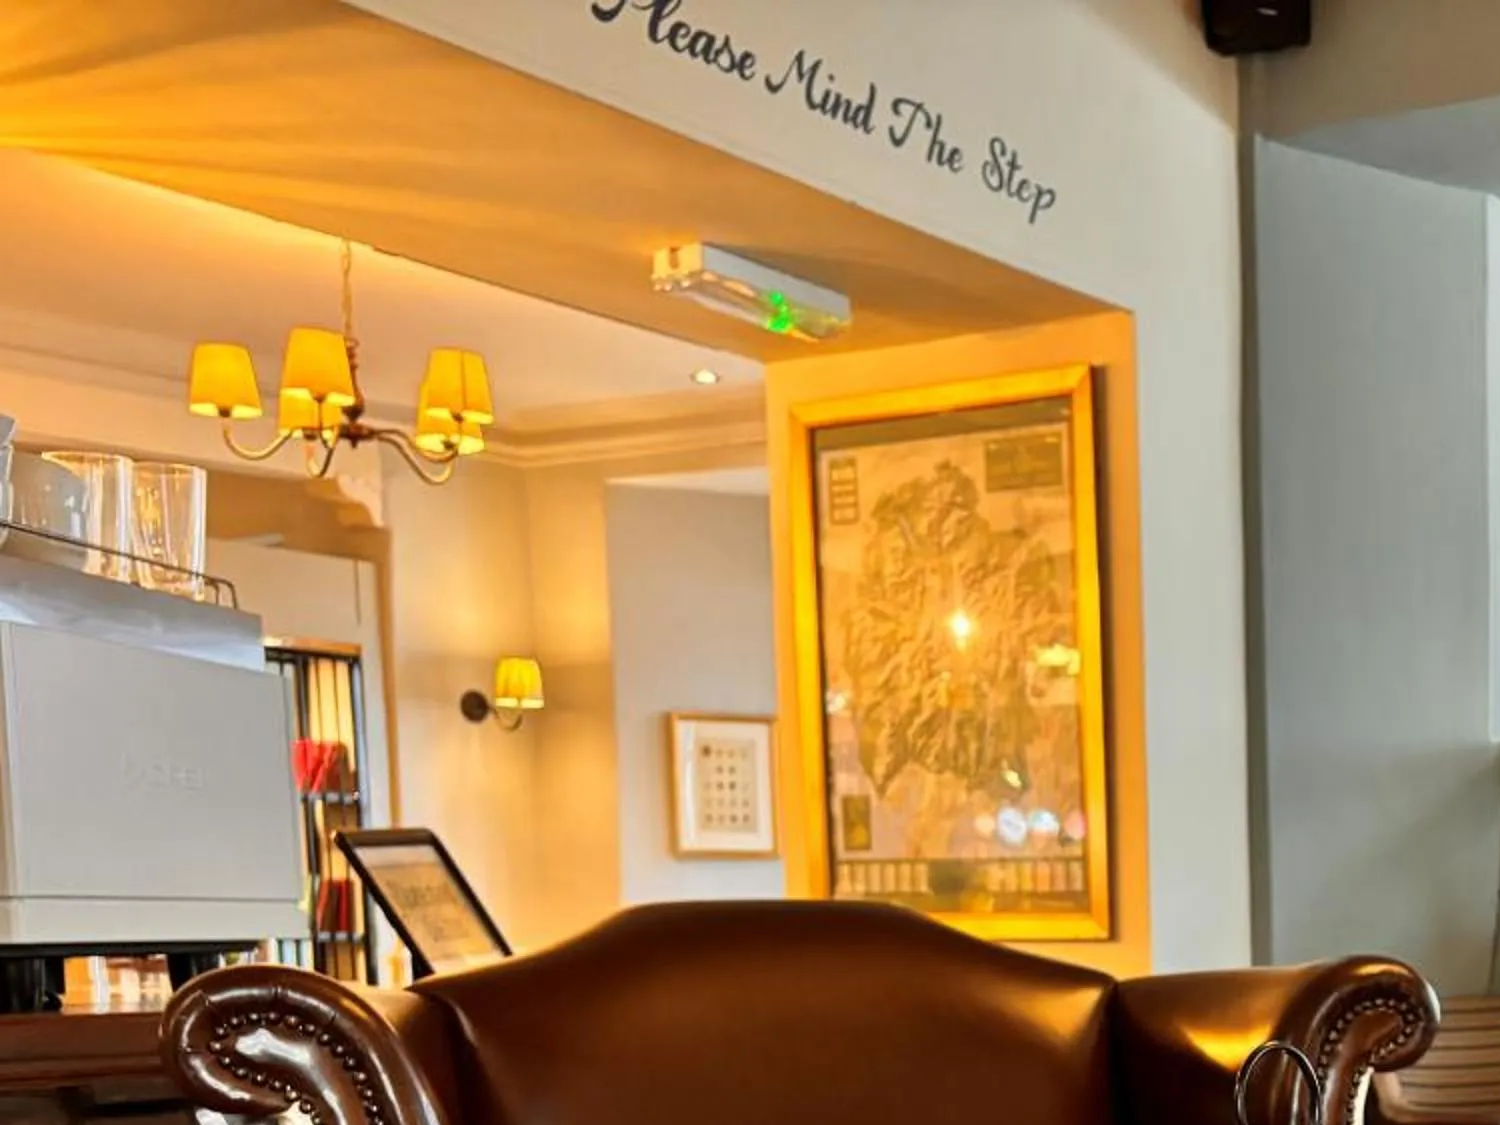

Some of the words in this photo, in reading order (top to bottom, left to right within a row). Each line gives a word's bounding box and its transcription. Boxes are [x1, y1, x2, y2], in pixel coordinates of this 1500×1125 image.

[764, 49, 877, 135] Mind
[888, 97, 965, 174] The
[982, 137, 1057, 225] Step
